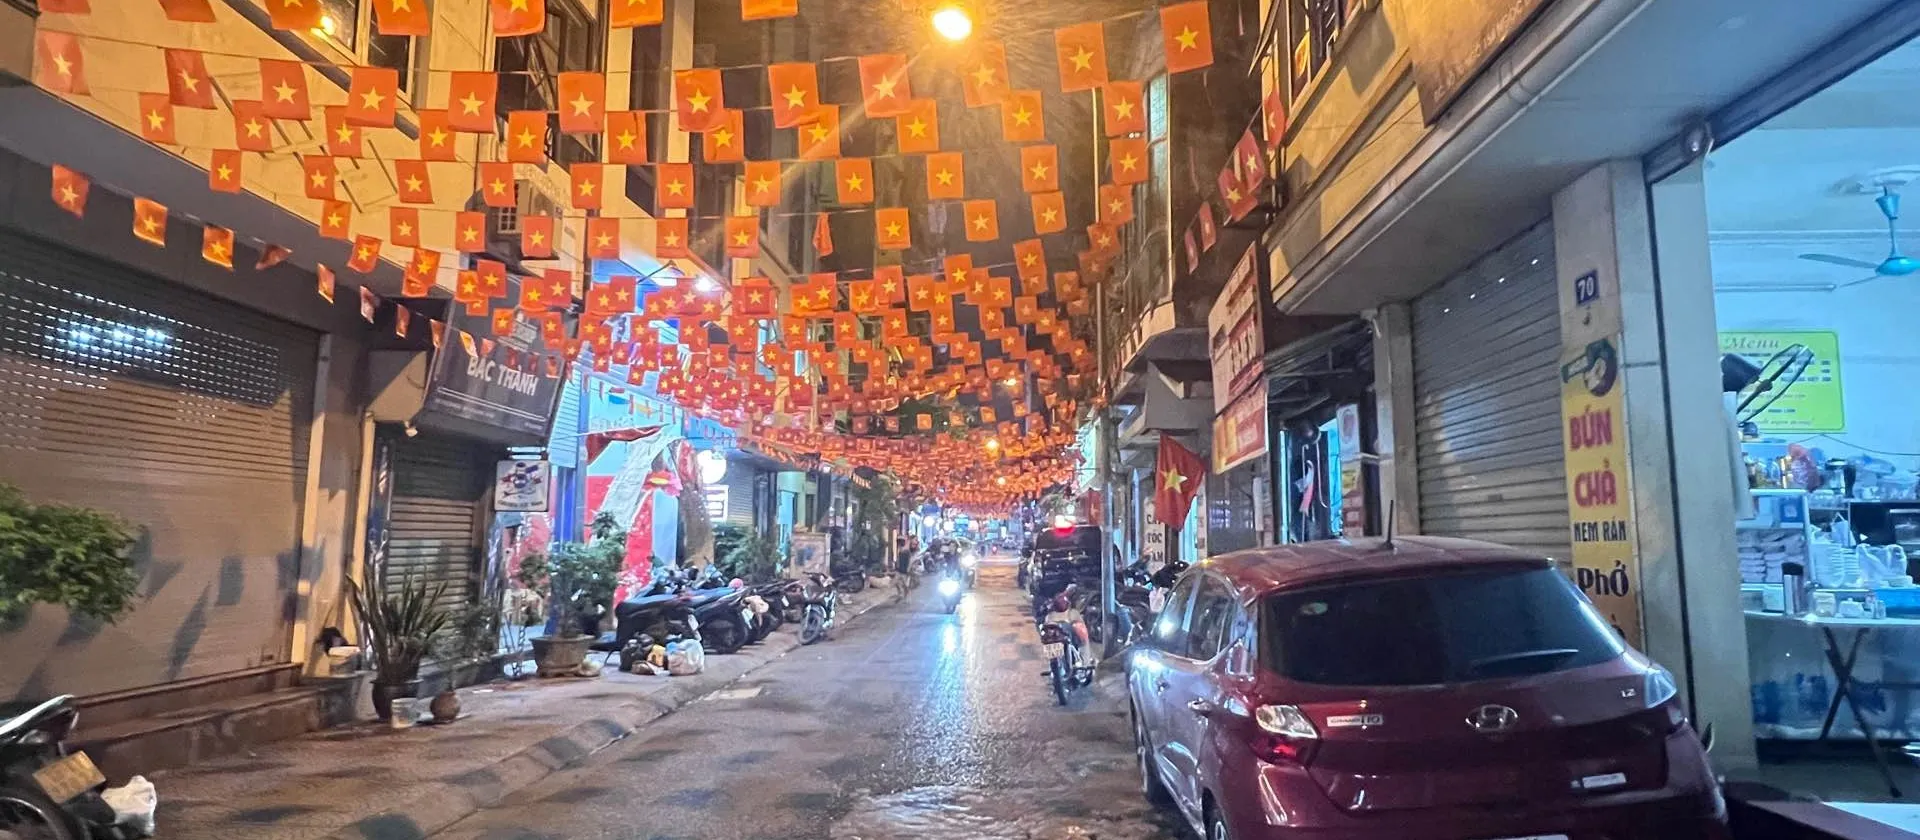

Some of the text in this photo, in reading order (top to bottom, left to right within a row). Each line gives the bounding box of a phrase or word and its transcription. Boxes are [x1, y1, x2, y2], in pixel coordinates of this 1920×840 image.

[1578, 277, 1595, 301] 70
[1569, 404, 1613, 451] BÚN
[1574, 459, 1617, 508] CHẢ
[1574, 516, 1627, 542] NEM RÁN
